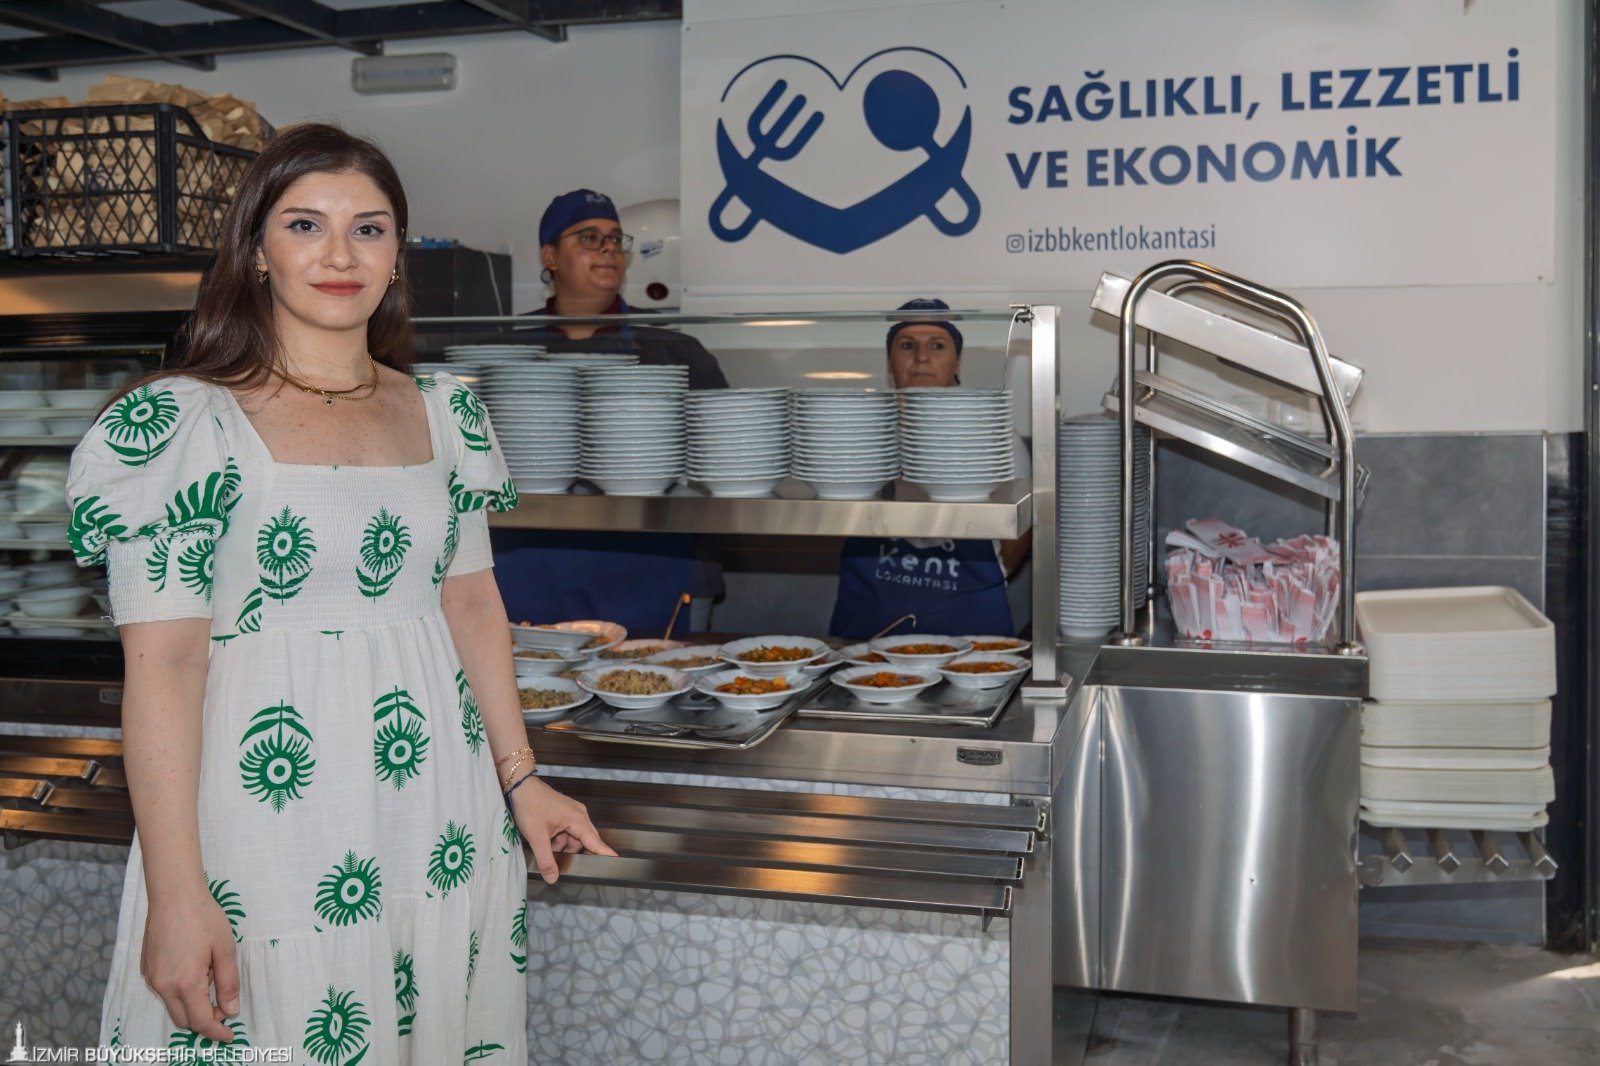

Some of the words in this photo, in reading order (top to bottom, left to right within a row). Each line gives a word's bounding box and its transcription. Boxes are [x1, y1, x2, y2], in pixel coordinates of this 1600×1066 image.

[1007, 70, 1259, 126] SAĞLIKLI,
[1280, 47, 1521, 112] LEZZETLİ
[1007, 150, 1068, 189] VE
[1085, 126, 1402, 188] EKONOMİK
[1028, 224, 1216, 253] izbbkentlokantasi
[878, 543, 960, 578] Kent
